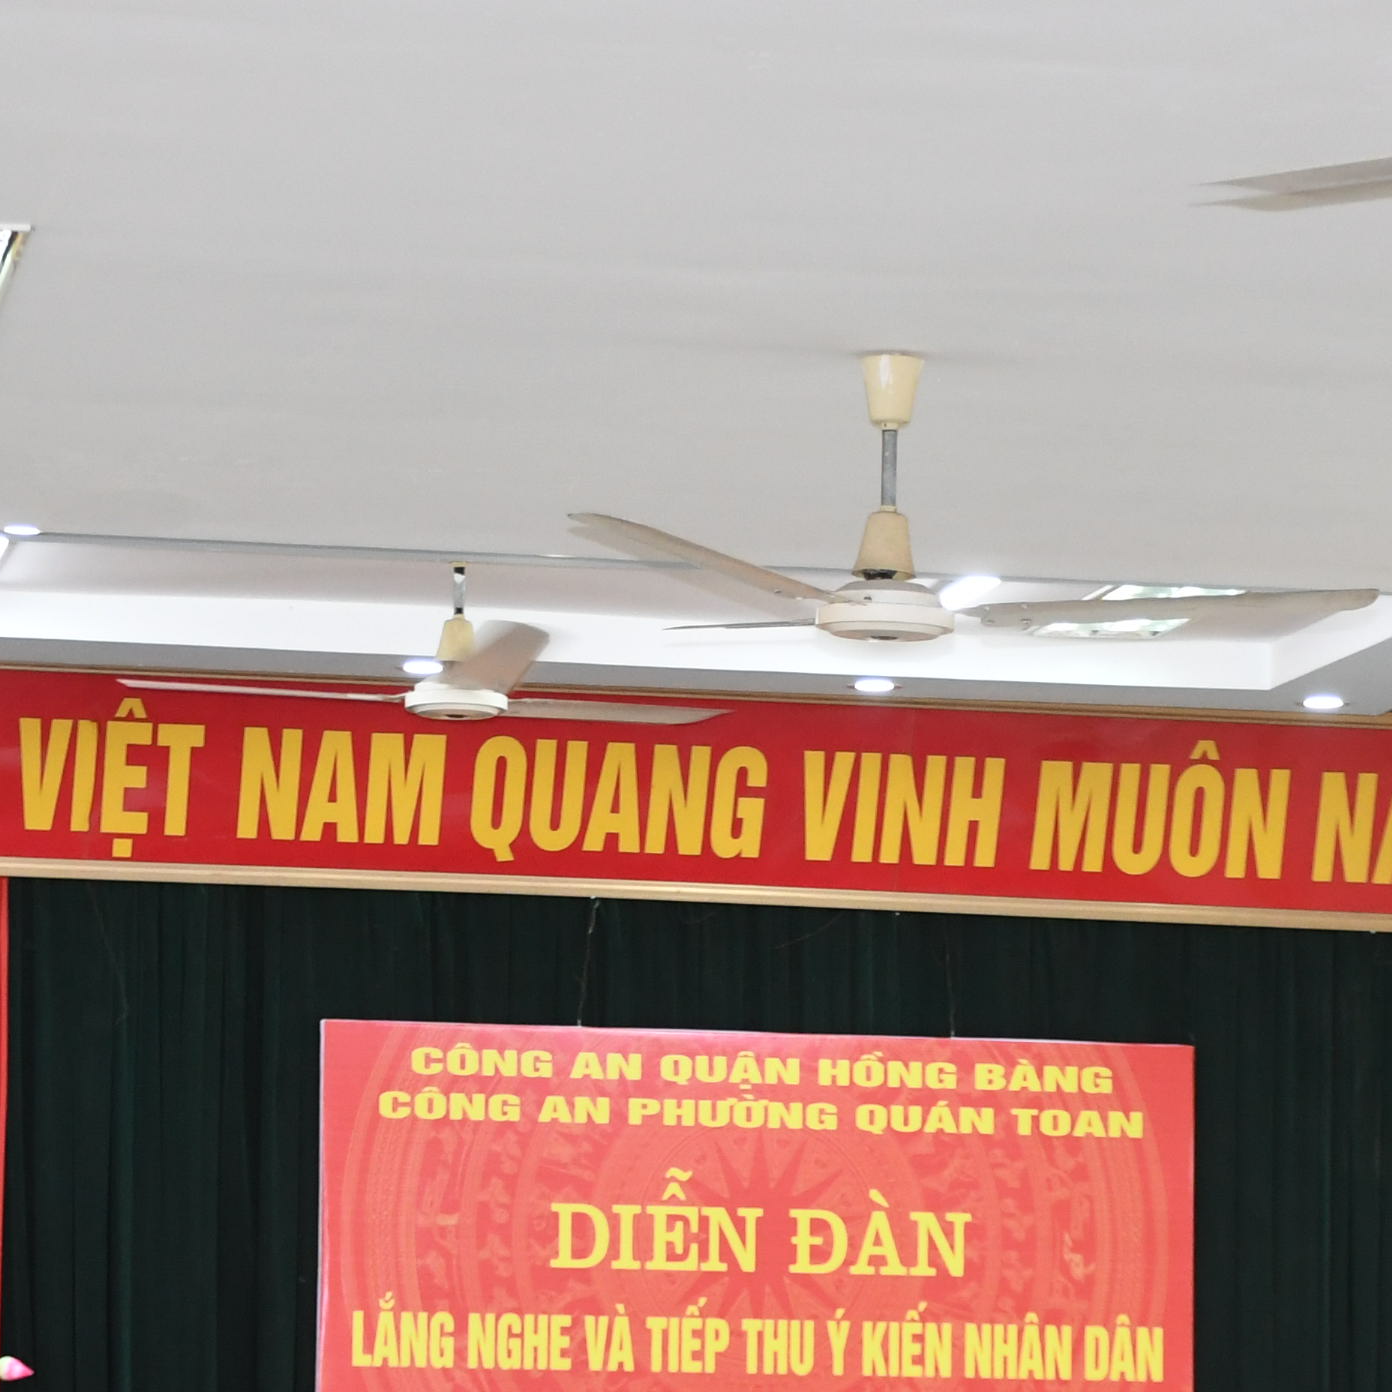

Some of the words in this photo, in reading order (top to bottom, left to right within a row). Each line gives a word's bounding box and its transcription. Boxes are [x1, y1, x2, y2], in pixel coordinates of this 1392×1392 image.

[20, 698, 205, 858] VIỆT
[236, 727, 447, 846] NAM
[470, 735, 768, 862] QUANG
[804, 750, 1005, 868] VINH
[1029, 740, 1290, 879] MUÔN
[379, 1086, 522, 1121] CÔNG
[539, 1095, 611, 1125] AN
[628, 1093, 839, 1131] PHƯỜNG
[855, 1100, 996, 1135] QUÁN
[1011, 1107, 1145, 1139] TOAN
[411, 1043, 553, 1078] CÔNG
[571, 1052, 643, 1081] AN
[660, 1051, 801, 1090] QUẬN
[818, 1051, 958, 1089] HỒNG
[974, 1058, 1114, 1094] BÀNG
[549, 1167, 765, 1273] DIỄN
[789, 1188, 973, 1278] ĐÀN
[352, 1292, 456, 1369] LẮNG
[467, 1311, 573, 1371] NGHE
[584, 1303, 635, 1373] VÀ
[645, 1297, 731, 1374] TIẾP
[741, 1317, 816, 1377] THU
[826, 1307, 852, 1377] Ý
[861, 1301, 955, 1379] KIẾN
[963, 1311, 1073, 1381] NHÂN
[1083, 1313, 1165, 1383] DÂN
